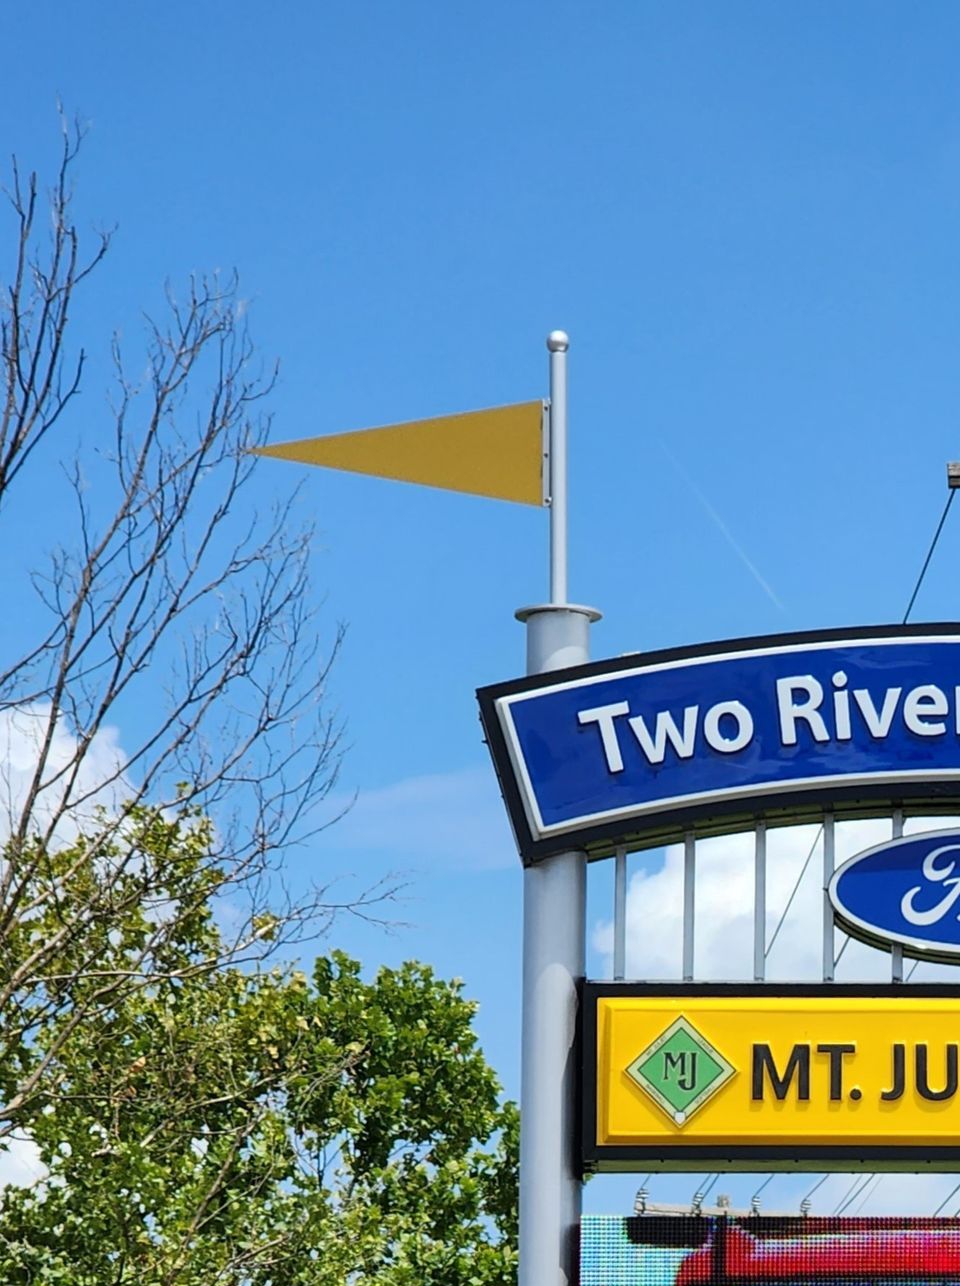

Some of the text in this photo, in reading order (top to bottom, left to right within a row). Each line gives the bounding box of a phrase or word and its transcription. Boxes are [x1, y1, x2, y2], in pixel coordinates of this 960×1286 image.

[577, 700, 754, 773] Two
[663, 1052, 697, 1091] MJ
[752, 1044, 862, 1101] MT.
